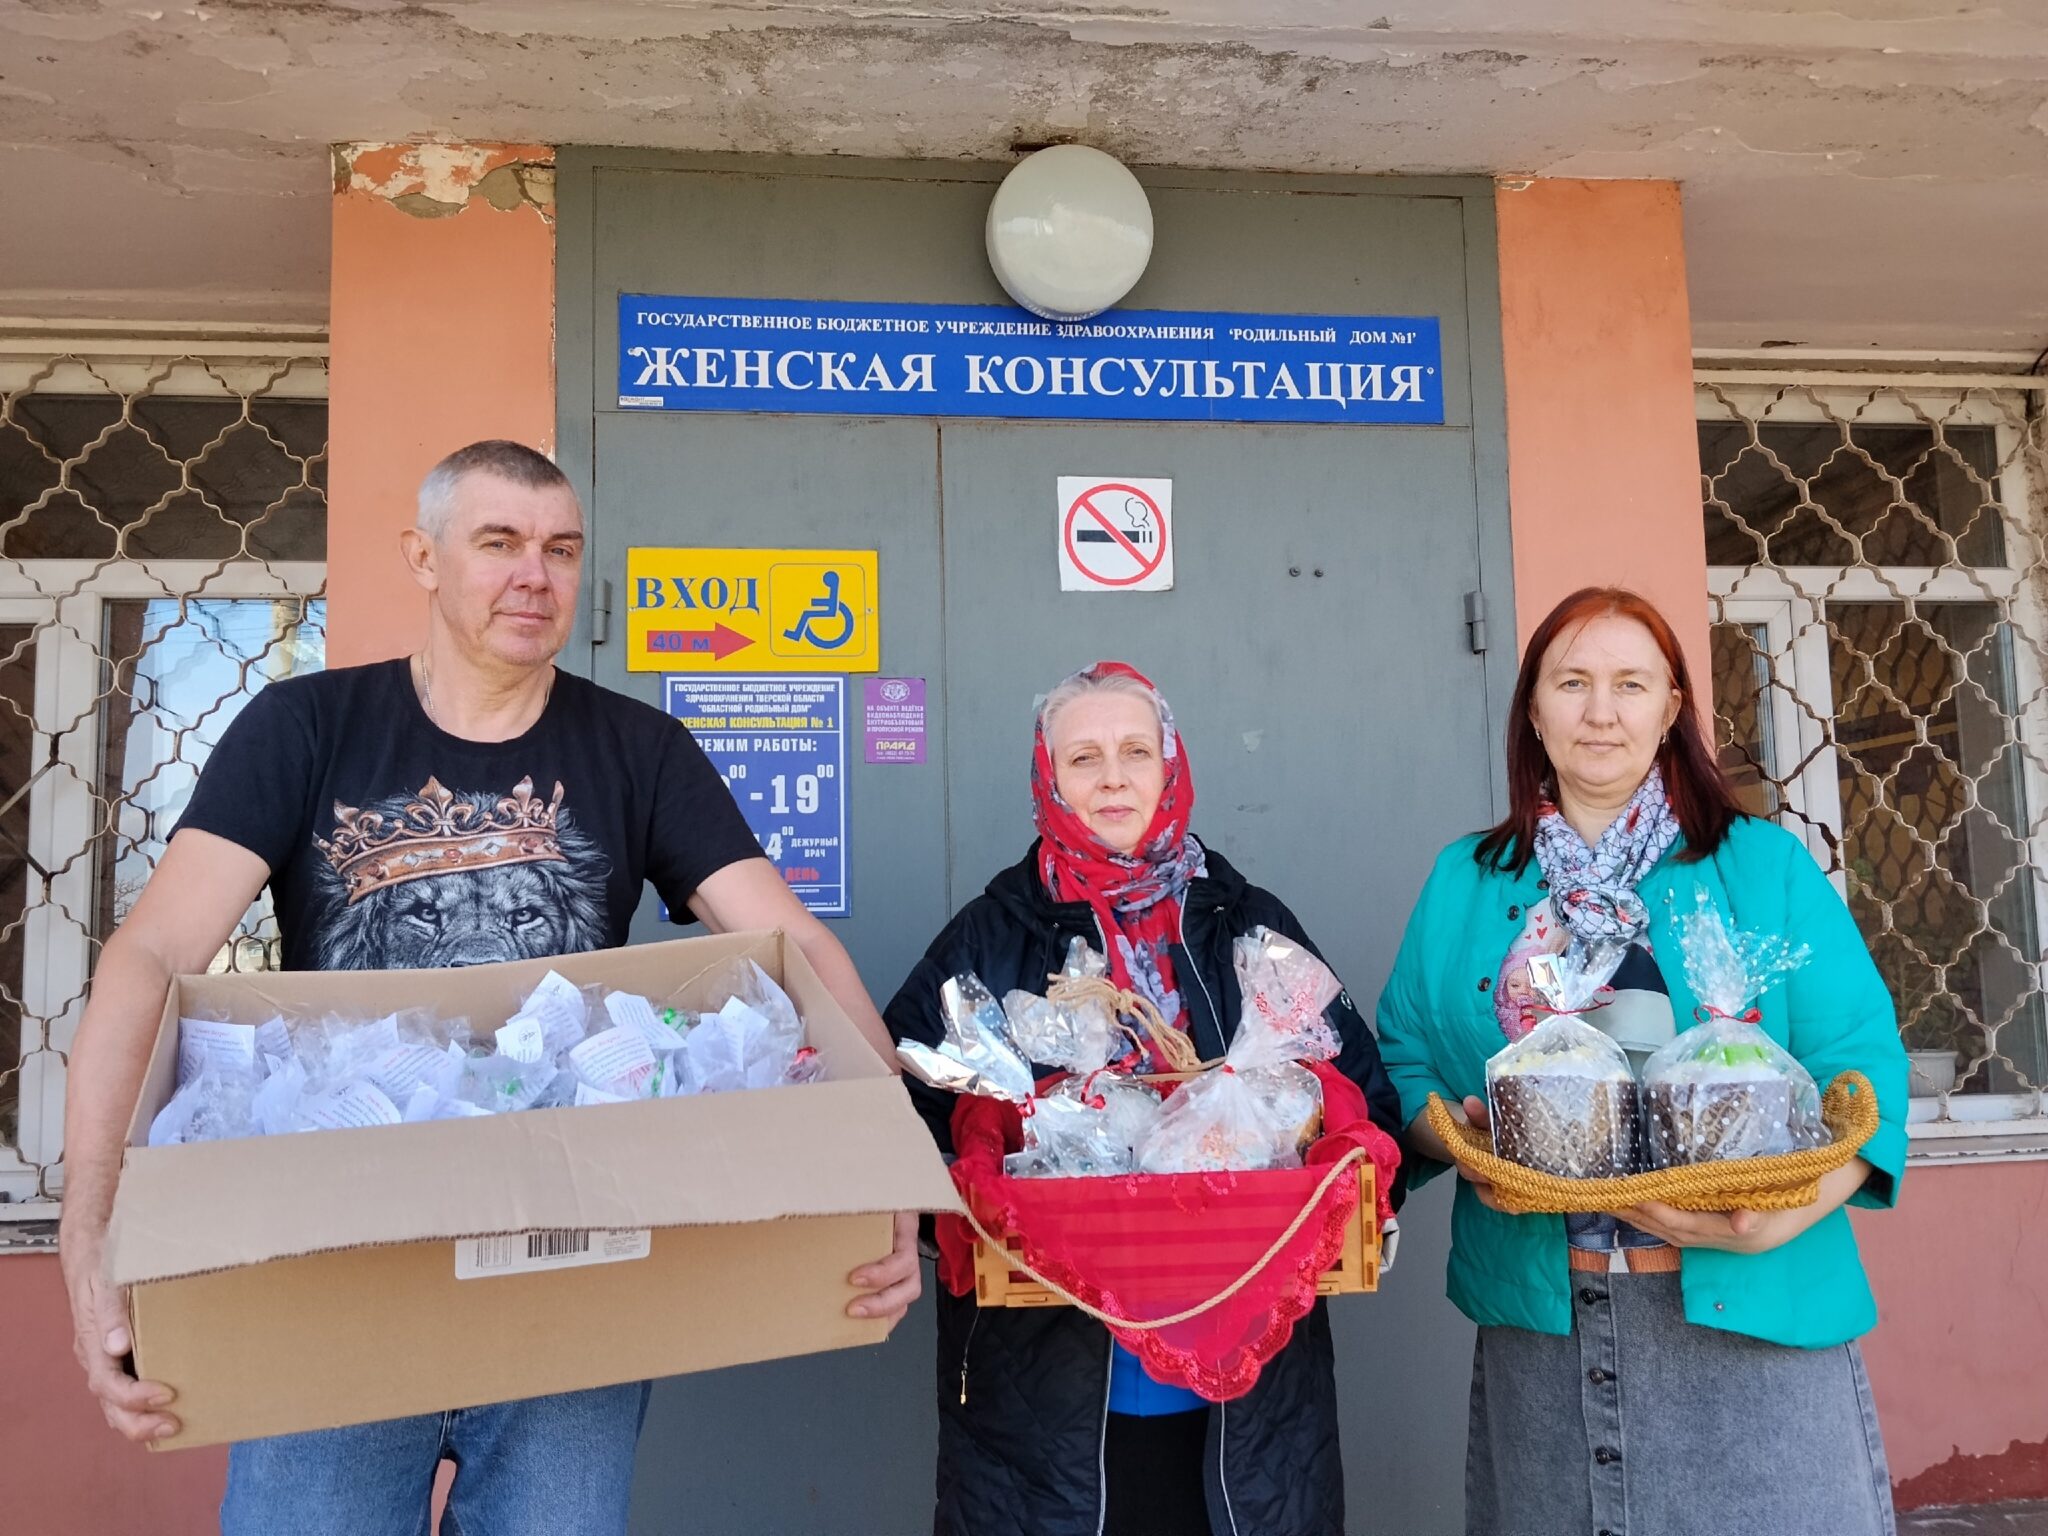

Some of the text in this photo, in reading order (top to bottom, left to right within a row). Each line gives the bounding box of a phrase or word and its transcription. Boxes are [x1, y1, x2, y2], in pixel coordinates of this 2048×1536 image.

[636, 311, 812, 331] ГОСУДАРСТВЕННОЕ
[816, 317, 930, 334] БЮДЖЕТНОЕ
[934, 319, 1052, 337] УЧРЕЖДЕНИЕ
[1055, 322, 1215, 341] ЗДРАВООХРАНЕНИЯ
[1349, 330, 1387, 344] ДОМ
[627, 346, 1426, 410] ЖЕНСКАЯ КОНСУЛЬТАЦИЯ
[634, 577, 760, 616] ВХОД
[652, 632, 710, 651] 40 м
[674, 683, 836, 693] ГОСУДАРСТВЕННОЕ БЮДЖЕТНОЕ УЧРЕЖДЕНИЕ
[684, 693, 825, 703] ЗДРАВООХРАНЕНИЯ ТВЕРСКОЙ ОБЛАСТИ
[745, 703, 790, 714] РОДИЛЬНЫЙ
[729, 716, 808, 730] КОНСУЛЬТАЦИЯ
[810, 717, 824, 729] №
[826, 716, 834, 728] 1
[753, 738, 818, 752] РАБОТЫ:
[876, 741, 916, 751] ПРАЙД
[790, 837, 839, 848] ДЕЖУРНЫЙ
[804, 848, 826, 858] ВРАЧ
